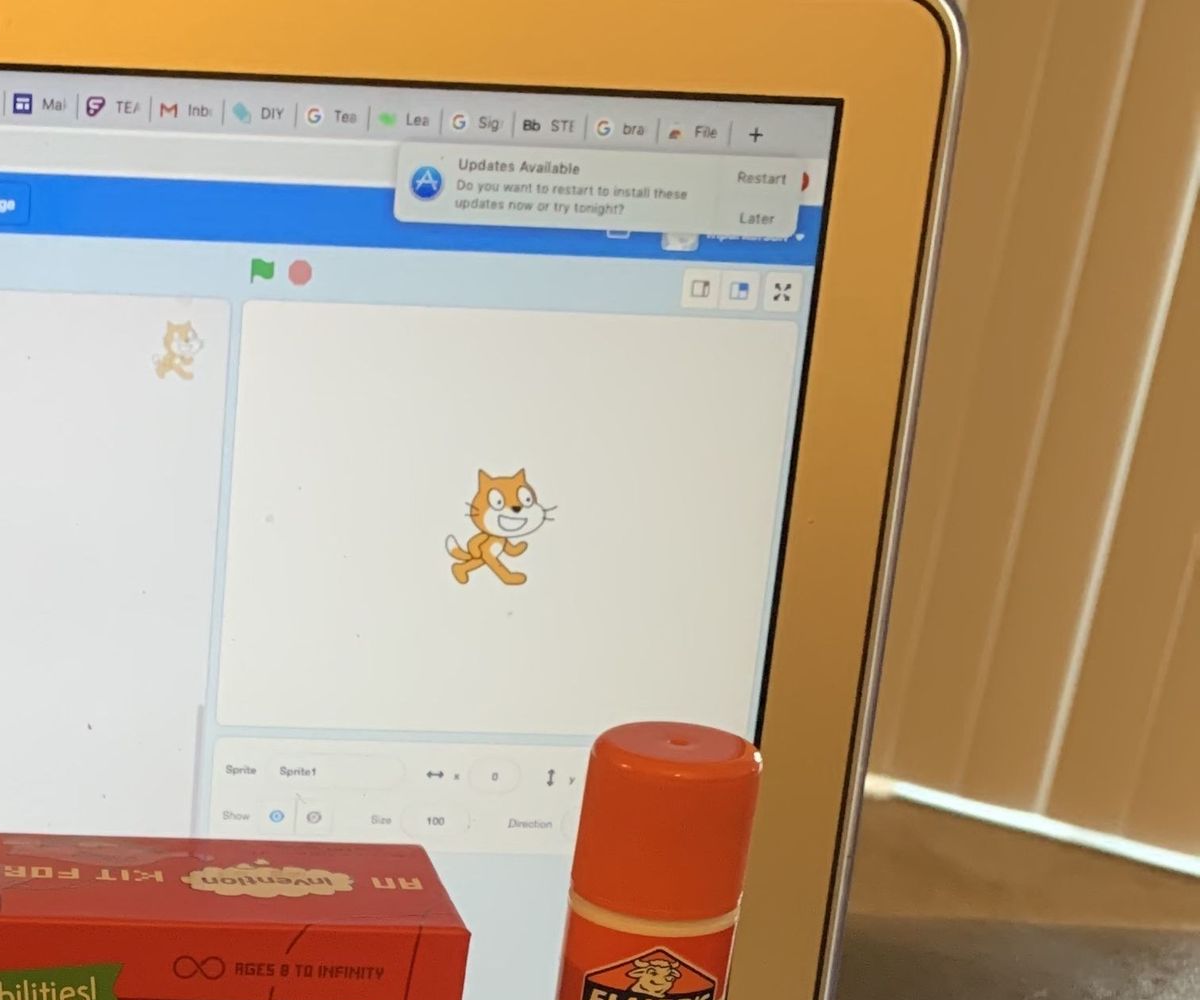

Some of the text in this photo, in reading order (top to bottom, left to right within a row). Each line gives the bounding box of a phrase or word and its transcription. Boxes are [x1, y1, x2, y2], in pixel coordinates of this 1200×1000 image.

[261, 107, 284, 120] DIY
[406, 113, 429, 127] Lea
[523, 119, 541, 132] Bb
[695, 125, 718, 139] File
[458, 158, 580, 176] Updates Available
[737, 171, 787, 185] Restart
[456, 179, 688, 201] Do you want to restart to install these
[455, 197, 625, 217] updates now or try tonight?
[739, 212, 775, 226] Later
[225, 764, 257, 778] Sprite
[279, 765, 317, 779] Sprite1
[222, 811, 250, 822] Show
[371, 815, 392, 826] Size
[427, 816, 445, 827] 100
[508, 818, 553, 831] Direction
[4, 865, 80, 880] FOR
[96, 868, 164, 884] KIT
[371, 876, 424, 891] AN
[235, 962, 385, 981] AGES 8 TO INFINITY
